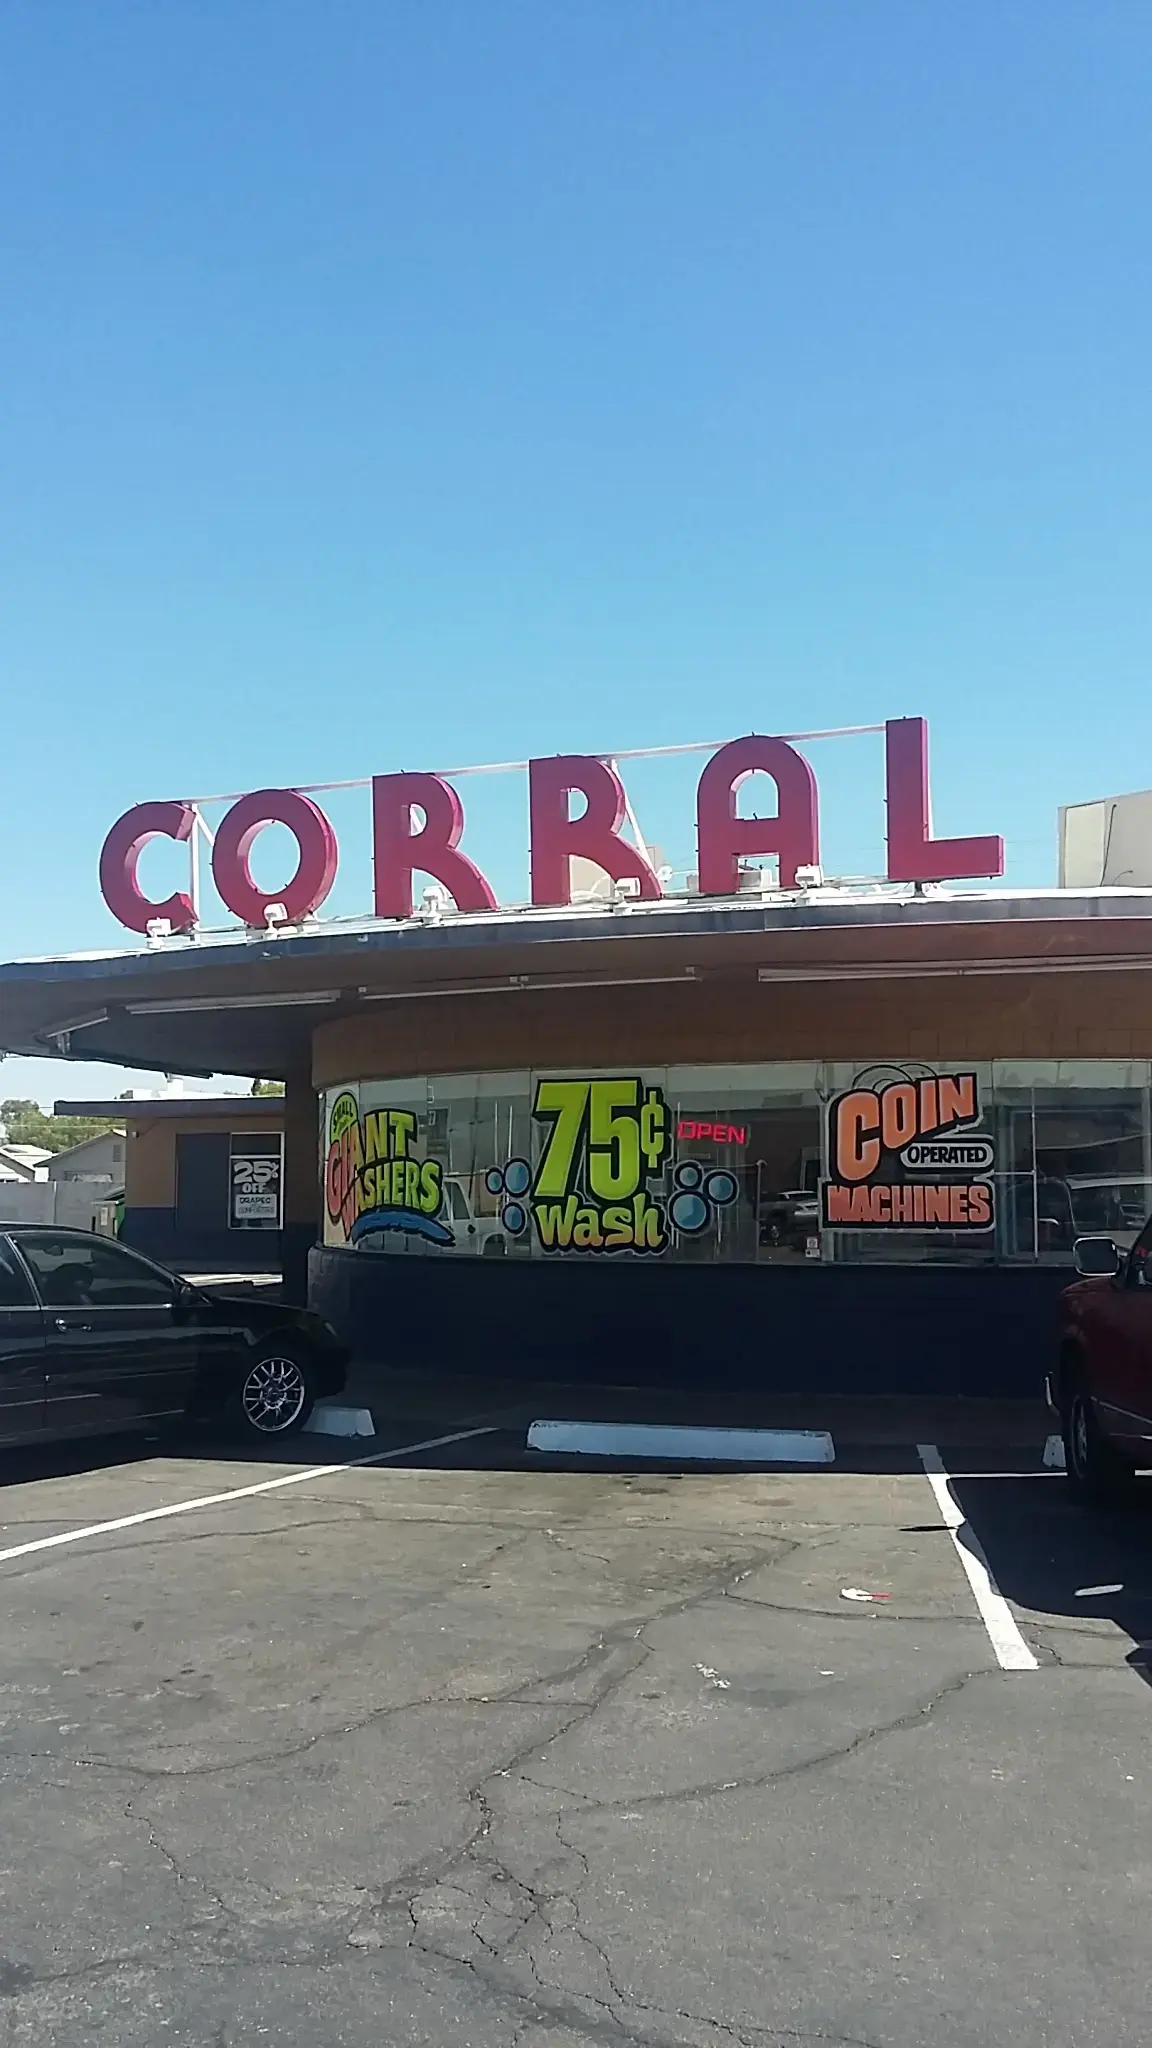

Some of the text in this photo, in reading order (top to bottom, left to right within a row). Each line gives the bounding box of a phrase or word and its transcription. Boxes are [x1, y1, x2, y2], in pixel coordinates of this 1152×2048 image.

[99, 716, 1004, 934] CORRAL
[533, 1079, 665, 1201] 75¢
[677, 1120, 746, 1145] OPEN
[836, 1076, 975, 1181] COIN
[906, 1146, 988, 1165] OPERATED
[234, 1161, 279, 1185] 25%
[242, 1182, 267, 1193] OFF
[327, 1110, 416, 1220] GIANT
[341, 1160, 441, 1241] WASHERS
[535, 1193, 664, 1248] Wash
[827, 1184, 991, 1223] MACHINES
